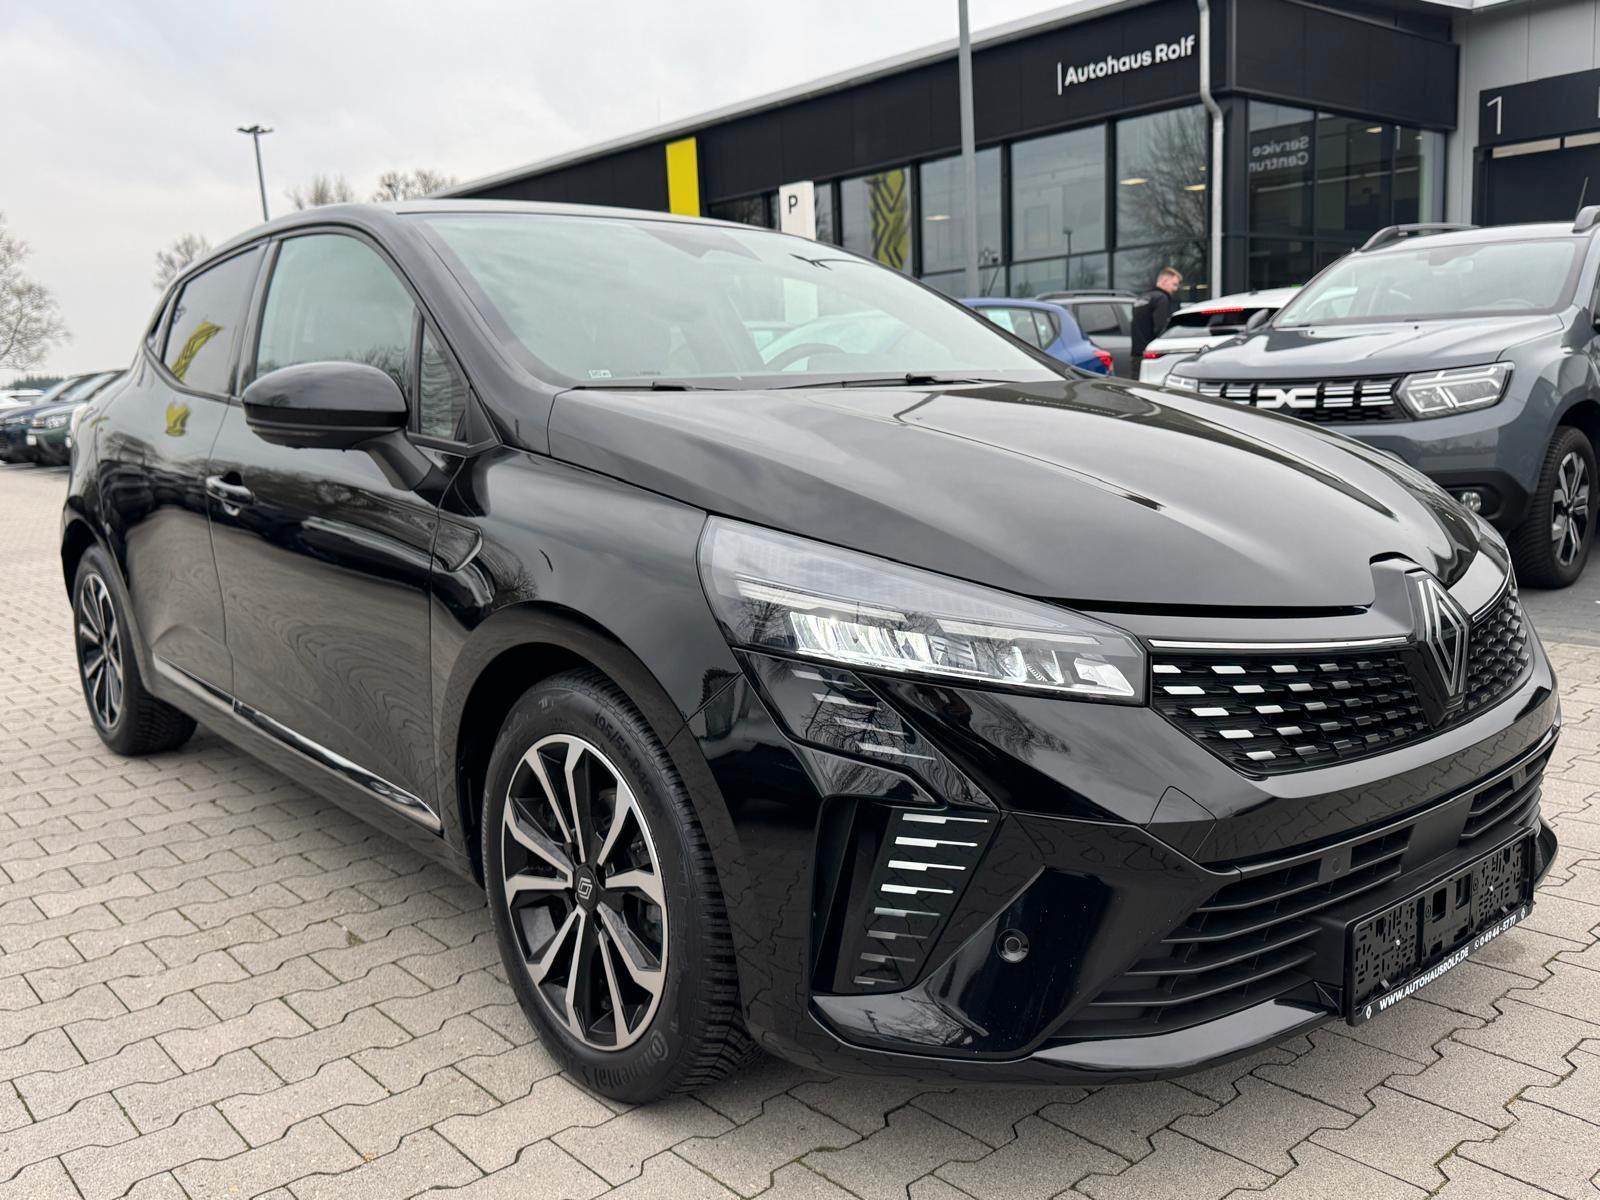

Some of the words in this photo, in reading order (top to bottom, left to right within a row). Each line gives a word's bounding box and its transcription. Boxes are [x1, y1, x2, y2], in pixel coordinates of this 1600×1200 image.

[1064, 50, 1152, 86] Autohaus
[1154, 35, 1195, 63] Rolf
[1486, 95, 1503, 135] 1
[788, 194, 798, 214] P
[1379, 946, 1469, 1011] WWW.AUTOHAUSROLF.DE
